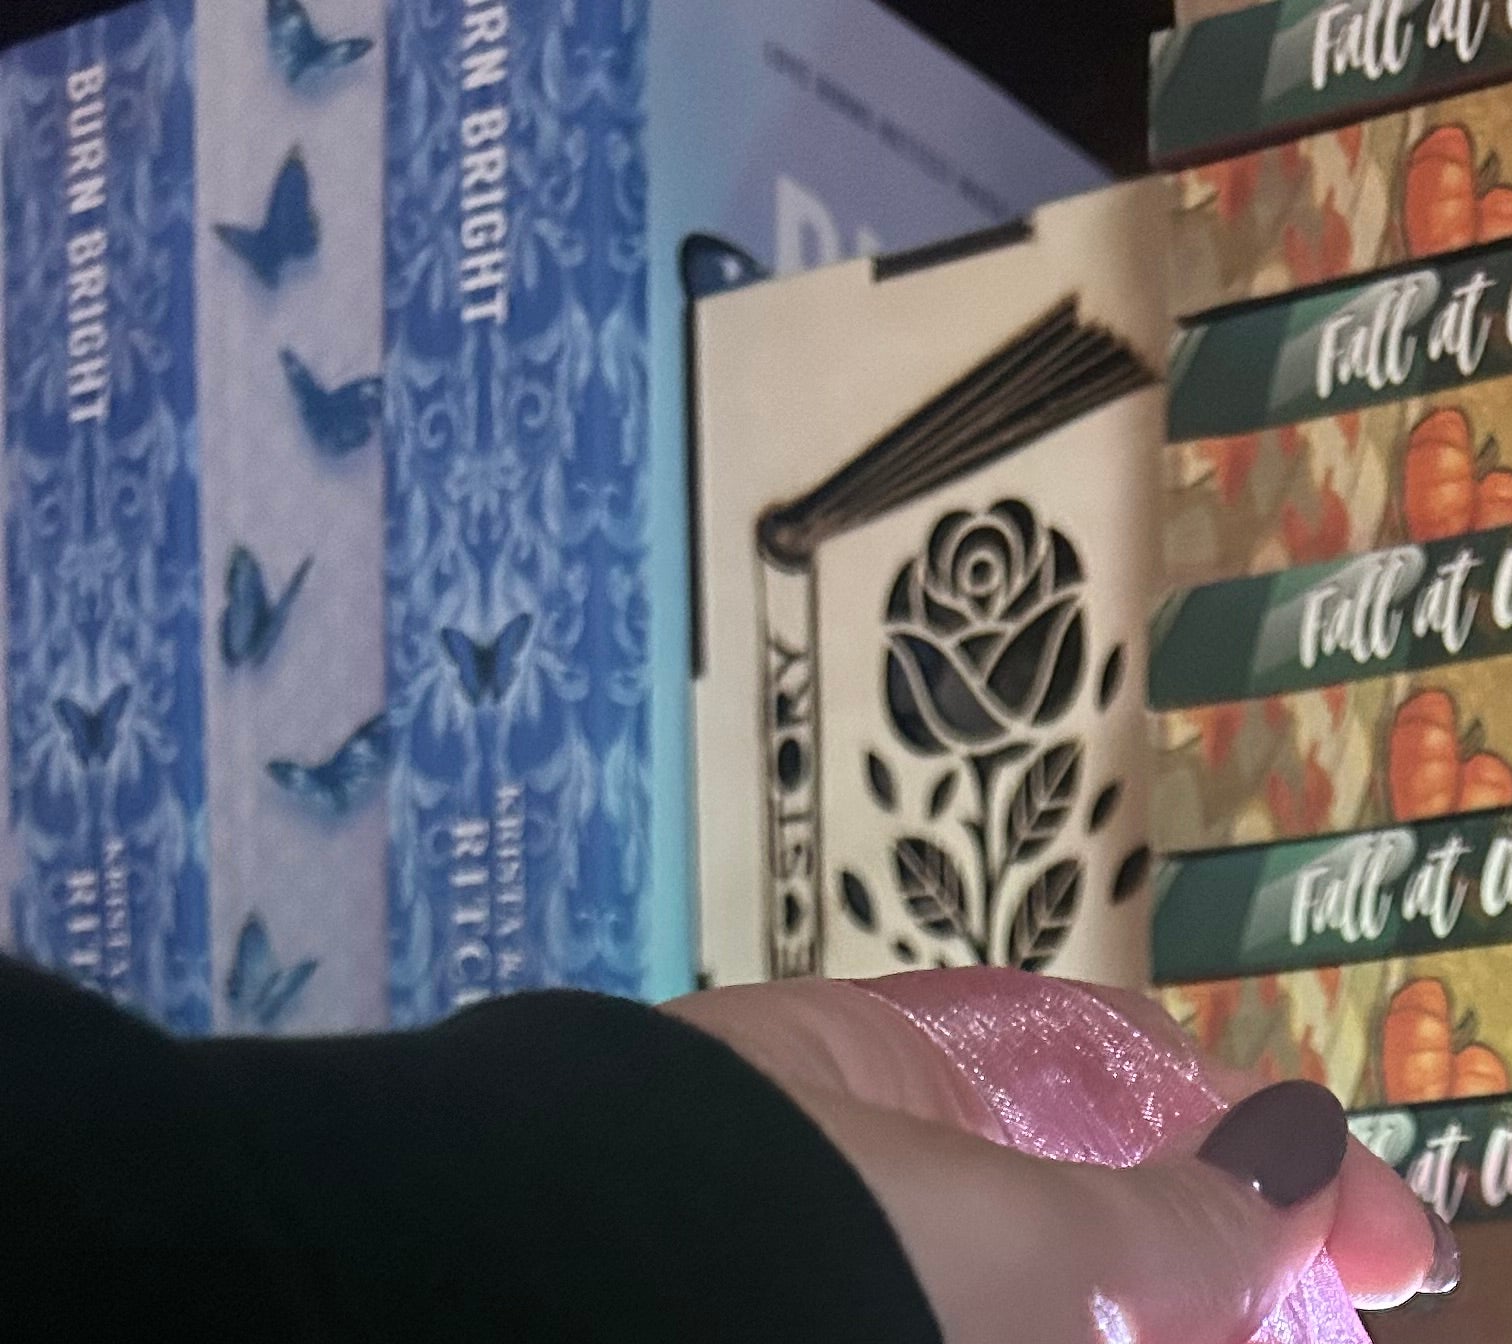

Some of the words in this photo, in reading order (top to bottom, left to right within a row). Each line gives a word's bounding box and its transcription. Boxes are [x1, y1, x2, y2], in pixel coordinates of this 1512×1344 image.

[459, 0, 508, 91] RN
[67, 66, 107, 214] BURN
[459, 107, 510, 324] BRIGHT
[67, 229, 111, 422] BRIGHT
[1316, 273, 1417, 397] Fall
[1428, 272, 1495, 375] at
[1299, 547, 1404, 669] Fall
[1413, 549, 1482, 653] at
[1288, 832, 1396, 945] Fall
[1400, 835, 1471, 938] at
